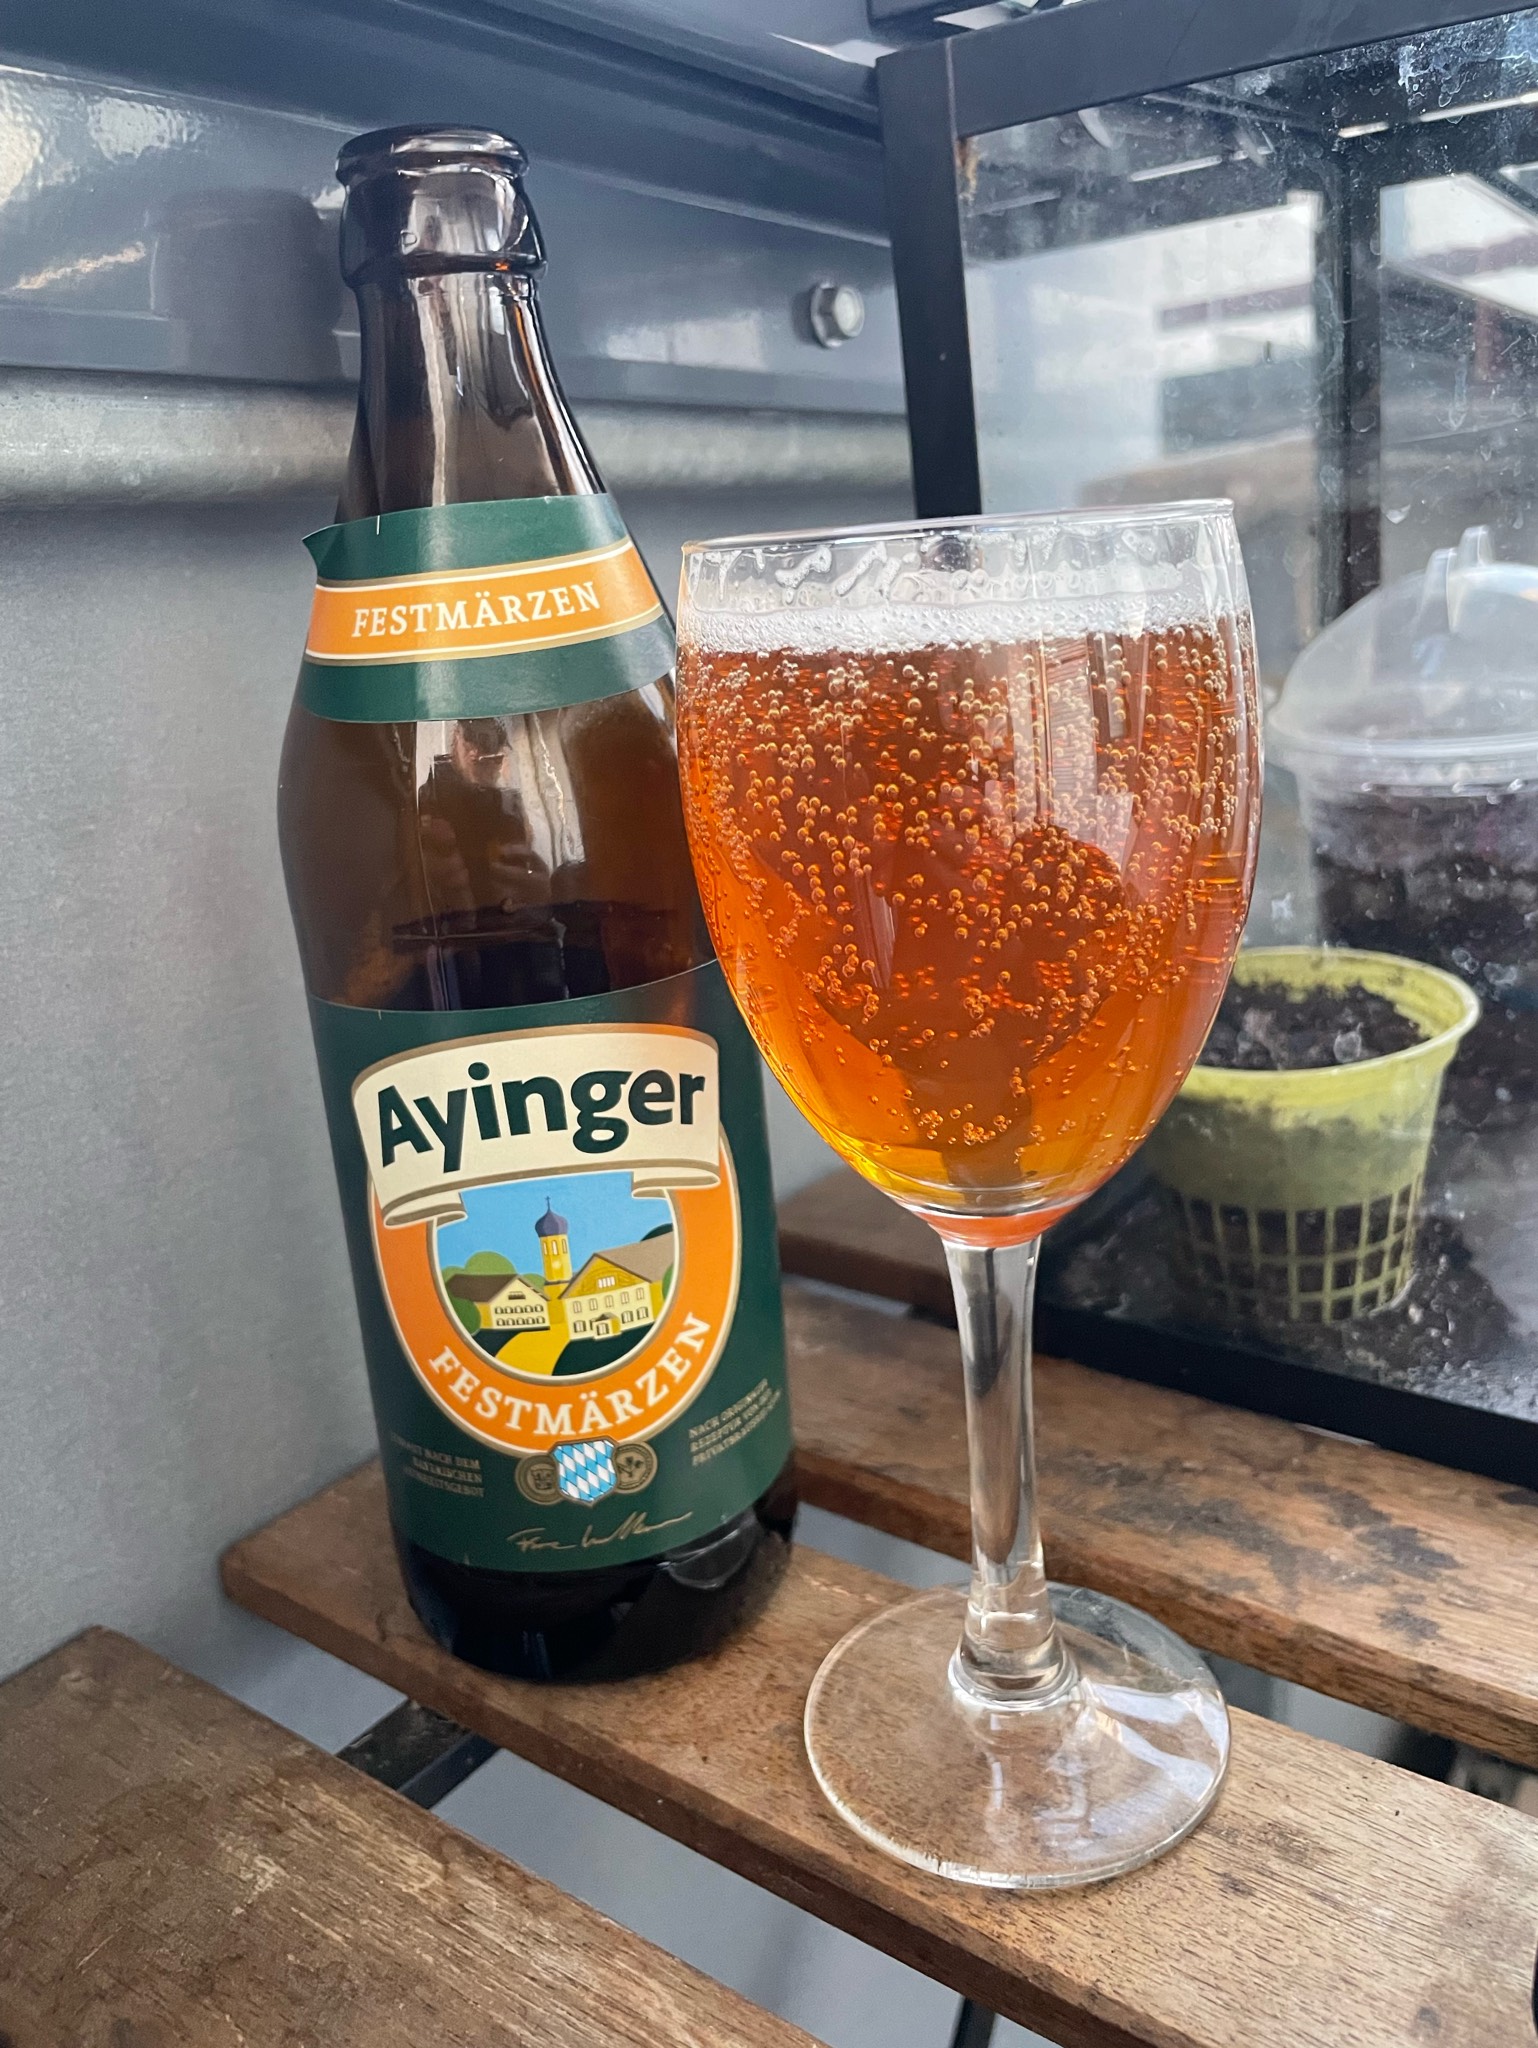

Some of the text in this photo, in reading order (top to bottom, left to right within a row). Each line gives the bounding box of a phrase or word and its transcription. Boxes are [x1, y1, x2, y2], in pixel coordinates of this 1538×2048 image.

[351, 581, 600, 638] FESTMÄRZEN
[377, 1061, 706, 1174] Ayinger
[428, 1311, 712, 1437] FESTMÄRZEN
